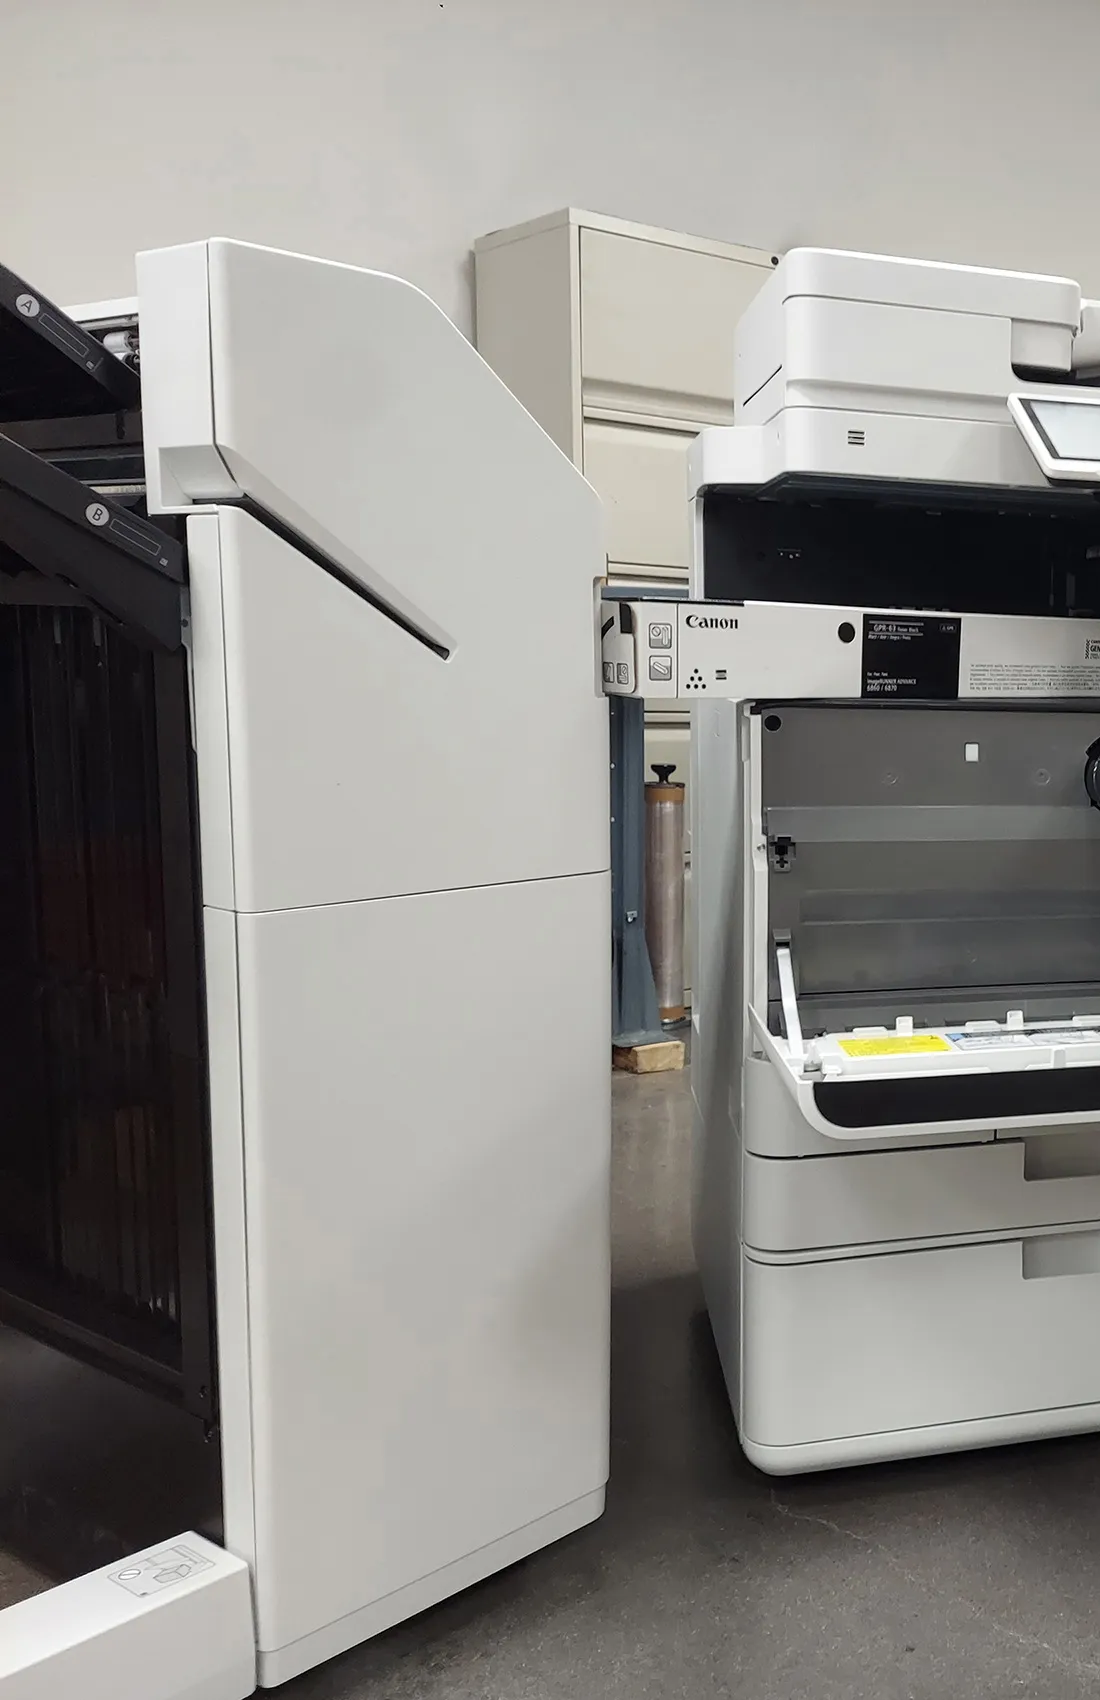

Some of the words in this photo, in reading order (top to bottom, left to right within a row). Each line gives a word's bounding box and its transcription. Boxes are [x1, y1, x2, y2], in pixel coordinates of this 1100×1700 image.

[20, 299, 33, 313] A
[92, 508, 104, 521] B
[685, 614, 739, 629] Canon
